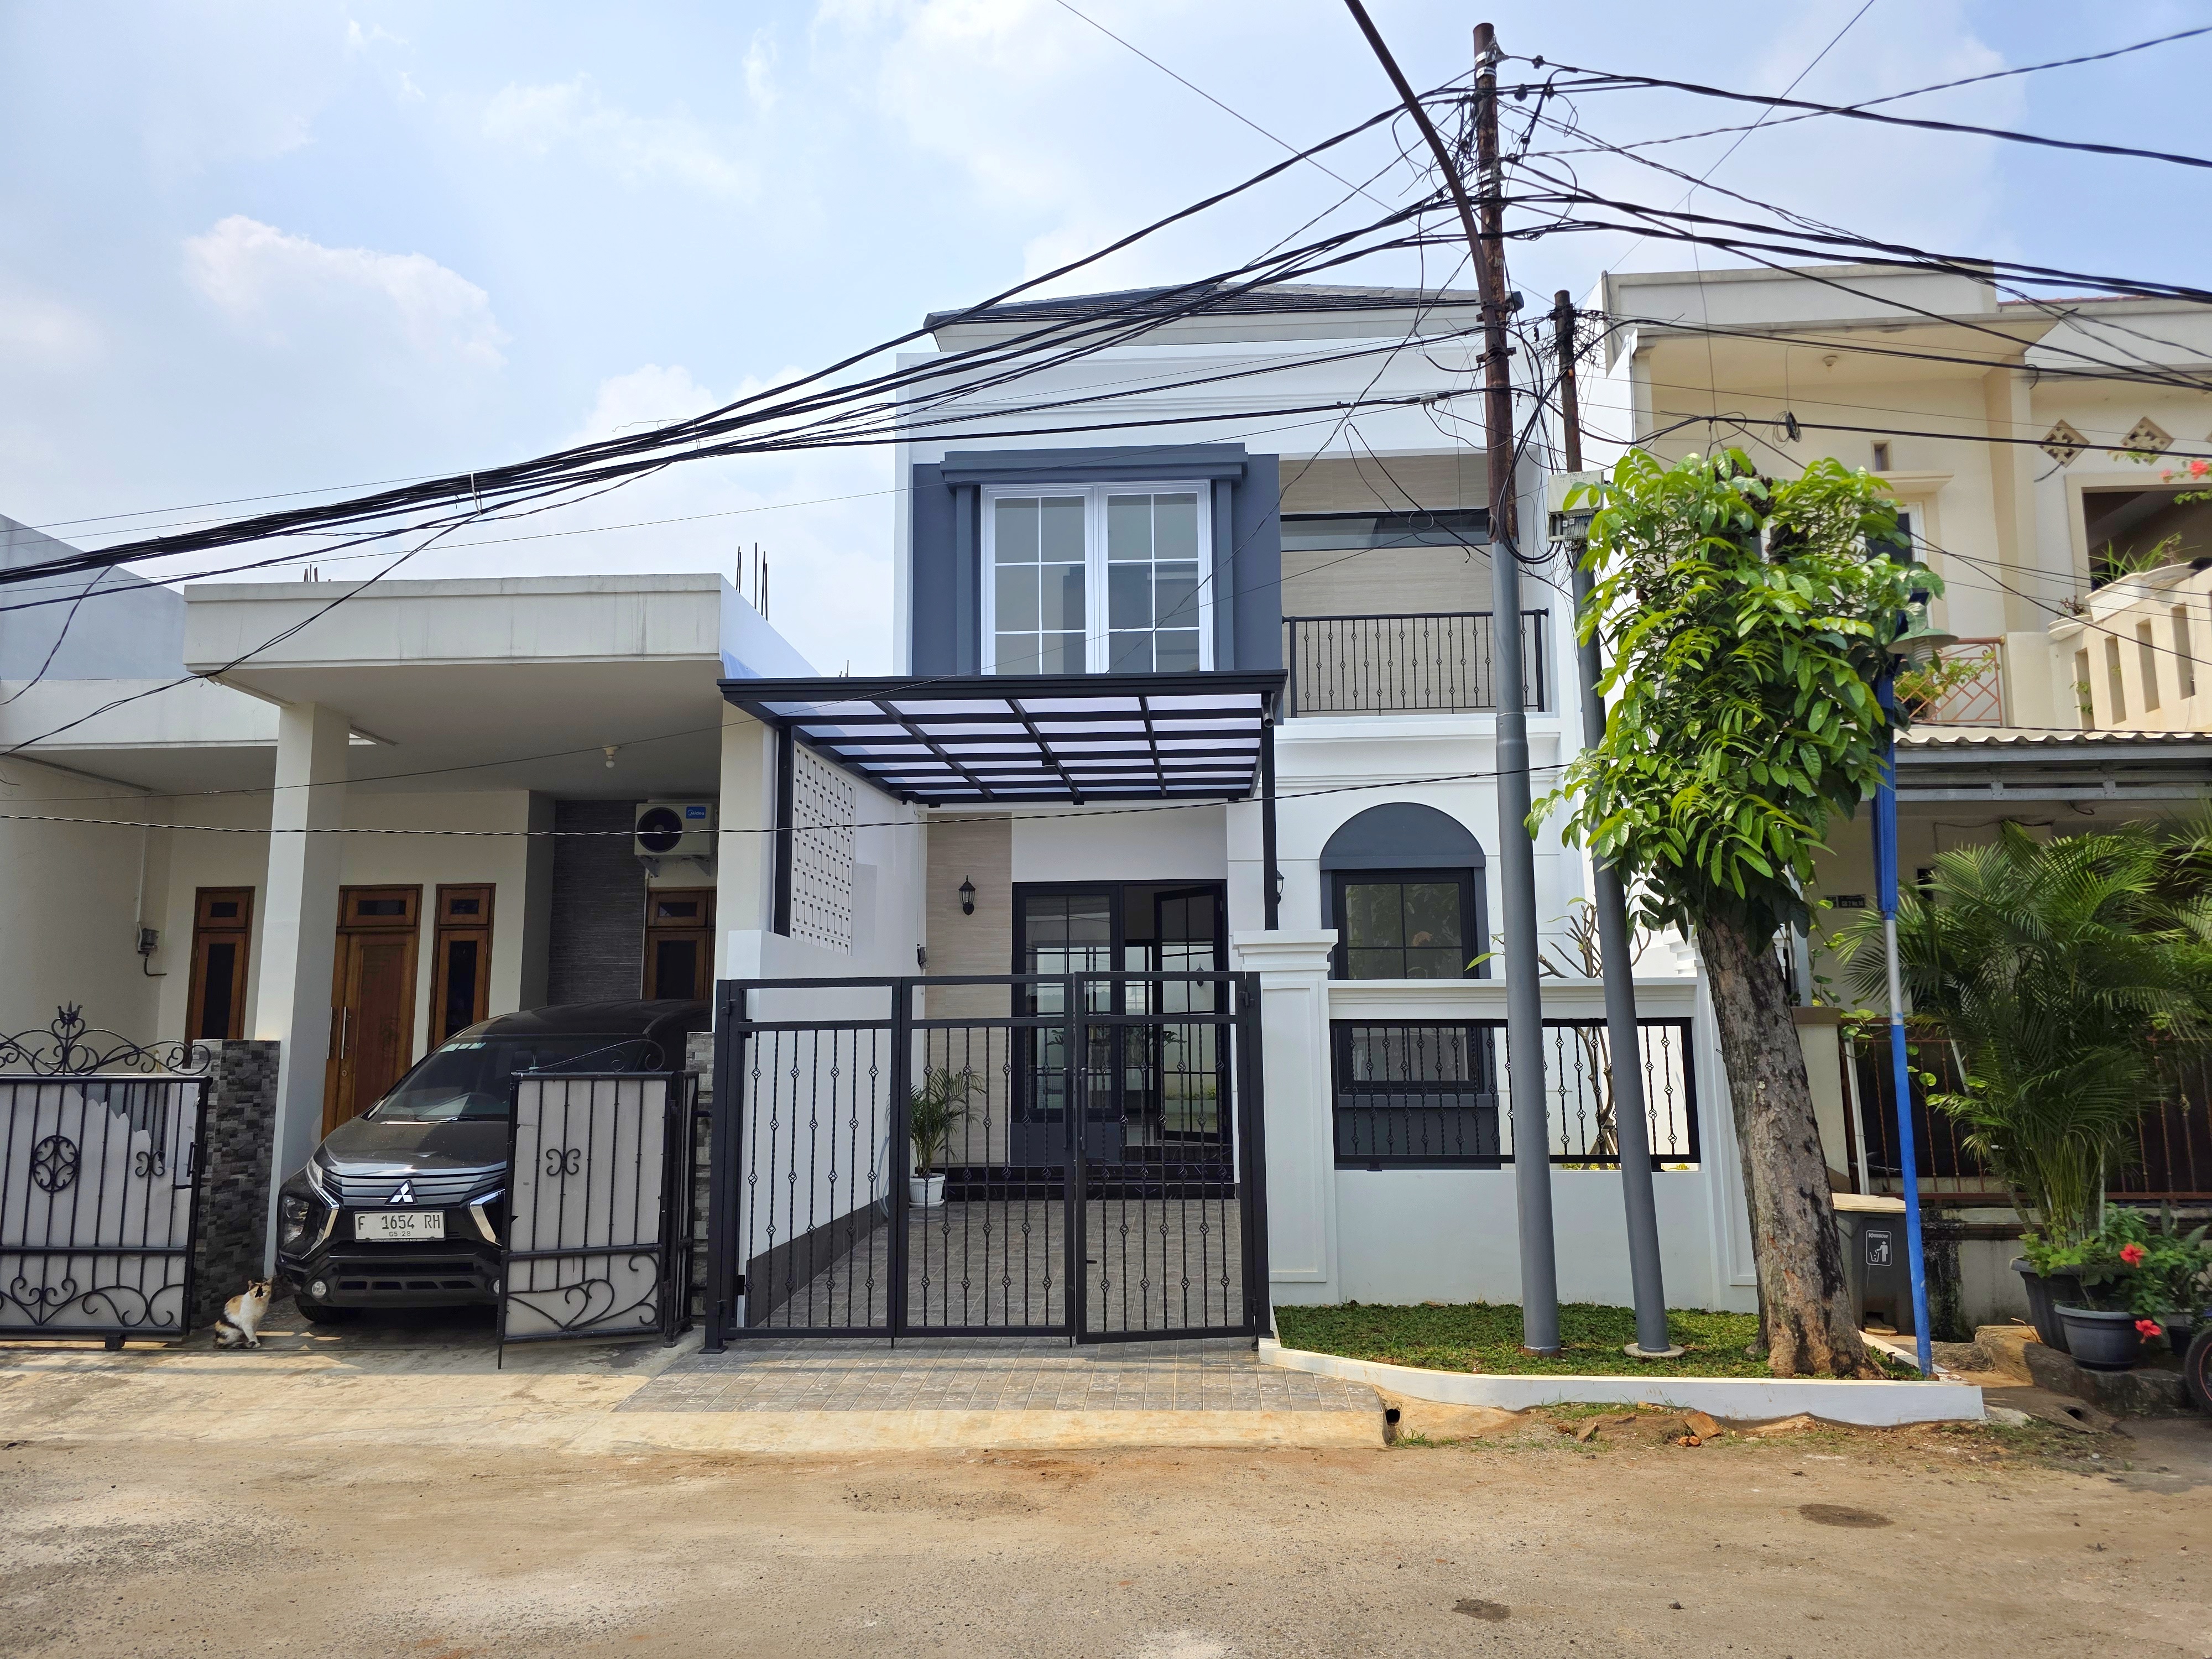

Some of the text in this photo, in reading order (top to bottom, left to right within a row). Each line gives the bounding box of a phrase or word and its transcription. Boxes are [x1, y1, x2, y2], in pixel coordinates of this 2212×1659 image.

[358, 1214, 440, 1230] F 1654 RH
